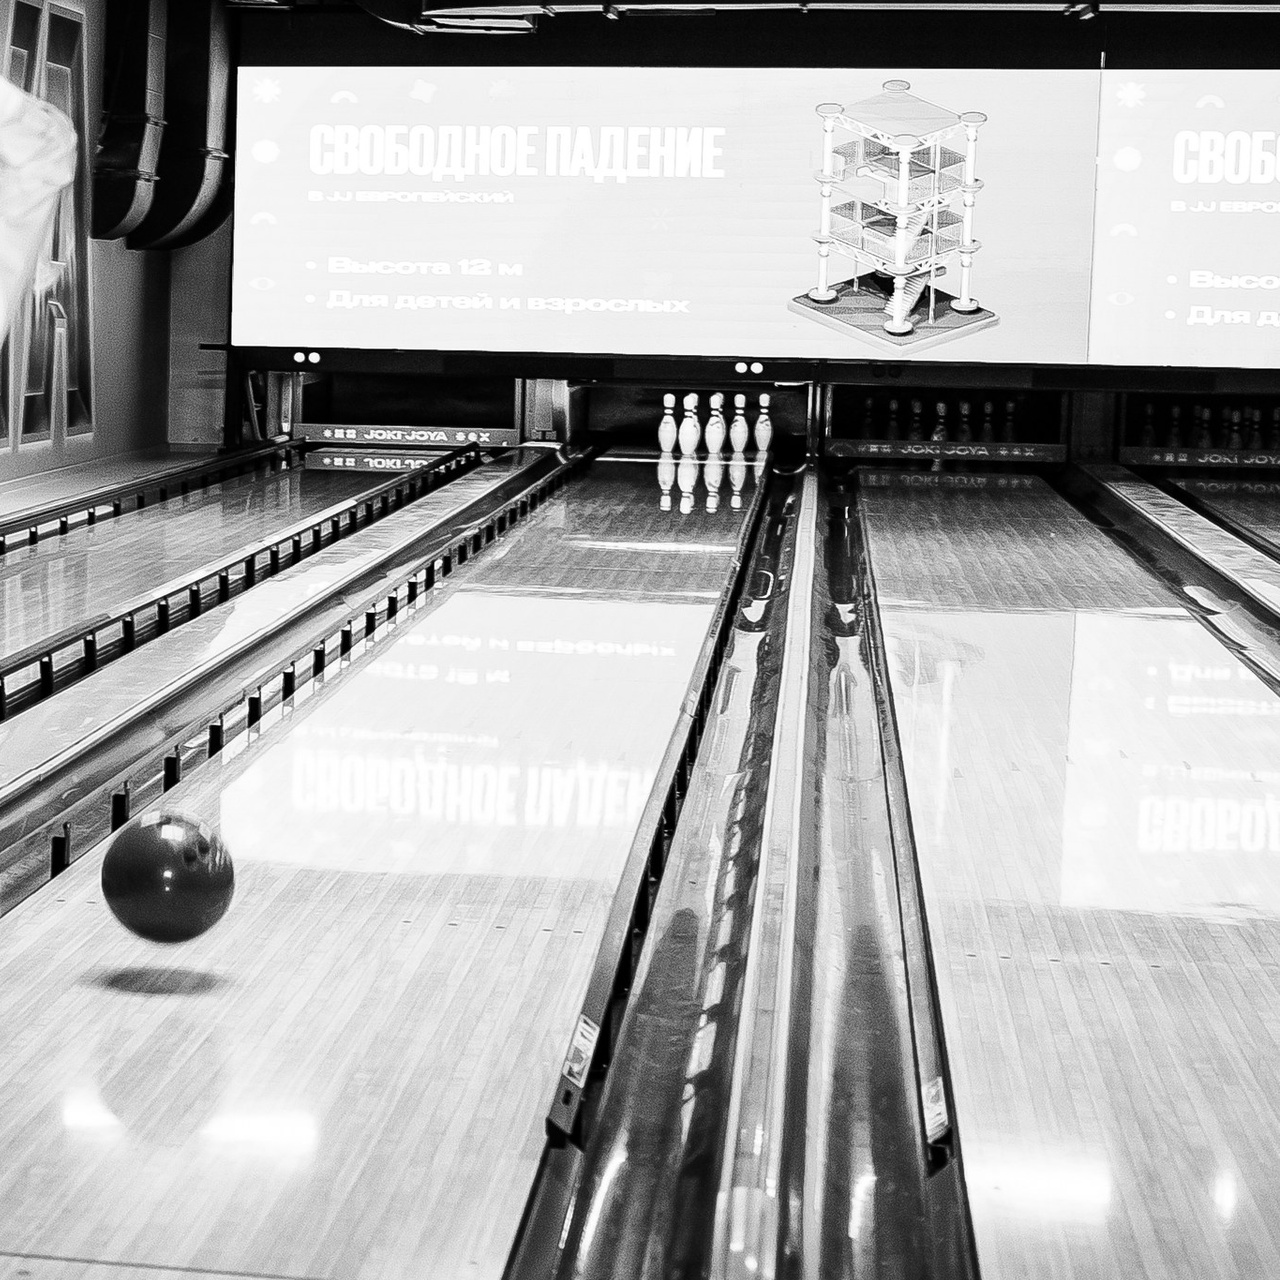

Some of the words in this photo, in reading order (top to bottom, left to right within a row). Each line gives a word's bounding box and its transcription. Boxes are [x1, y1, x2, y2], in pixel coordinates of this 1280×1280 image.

[309, 124, 539, 182] СВОБОДНОЕ
[545, 126, 726, 184] ПАДЕНИЕ
[1172, 130, 1280, 184] СВОБ
[307, 190, 324, 202] В
[355, 189, 515, 203] ЕВРОПЕЙСКИЙ
[1170, 200, 1187, 212] В
[327, 256, 451, 275] Высота
[457, 258, 492, 276] 12
[498, 263, 523, 276] м
[326, 289, 389, 309] Для
[394, 292, 494, 311] детей
[499, 296, 521, 310] и
[527, 297, 690, 315] взрослых
[1186, 305, 1251, 326] Для
[1243, 455, 1280, 464] JOY
